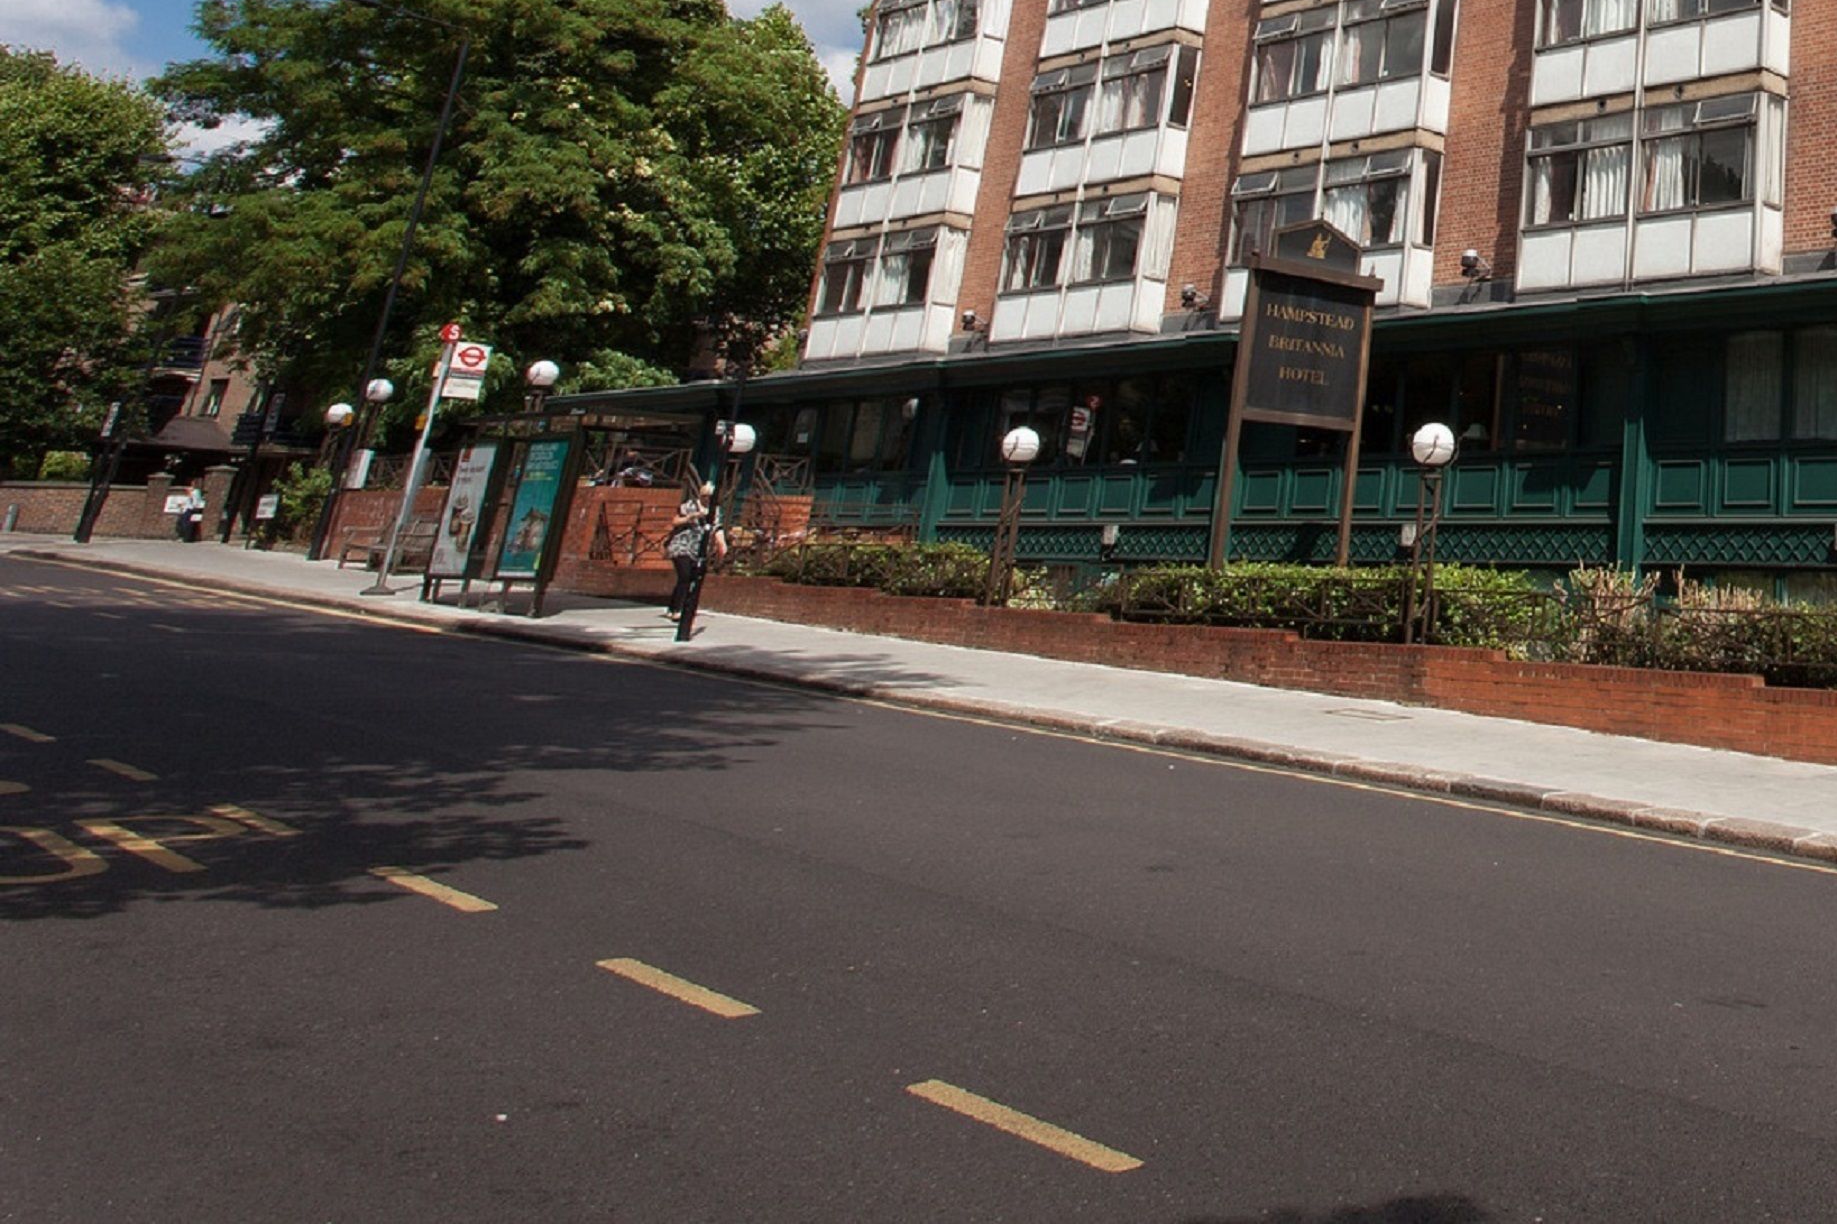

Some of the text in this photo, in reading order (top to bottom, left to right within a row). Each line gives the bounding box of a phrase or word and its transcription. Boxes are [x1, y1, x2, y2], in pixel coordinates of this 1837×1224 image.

[1266, 304, 1354, 330] HAMPSTEAD
[448, 324, 460, 339] S
[1268, 335, 1344, 358] BRITANNIA
[1278, 367, 1328, 385] HOTEL
